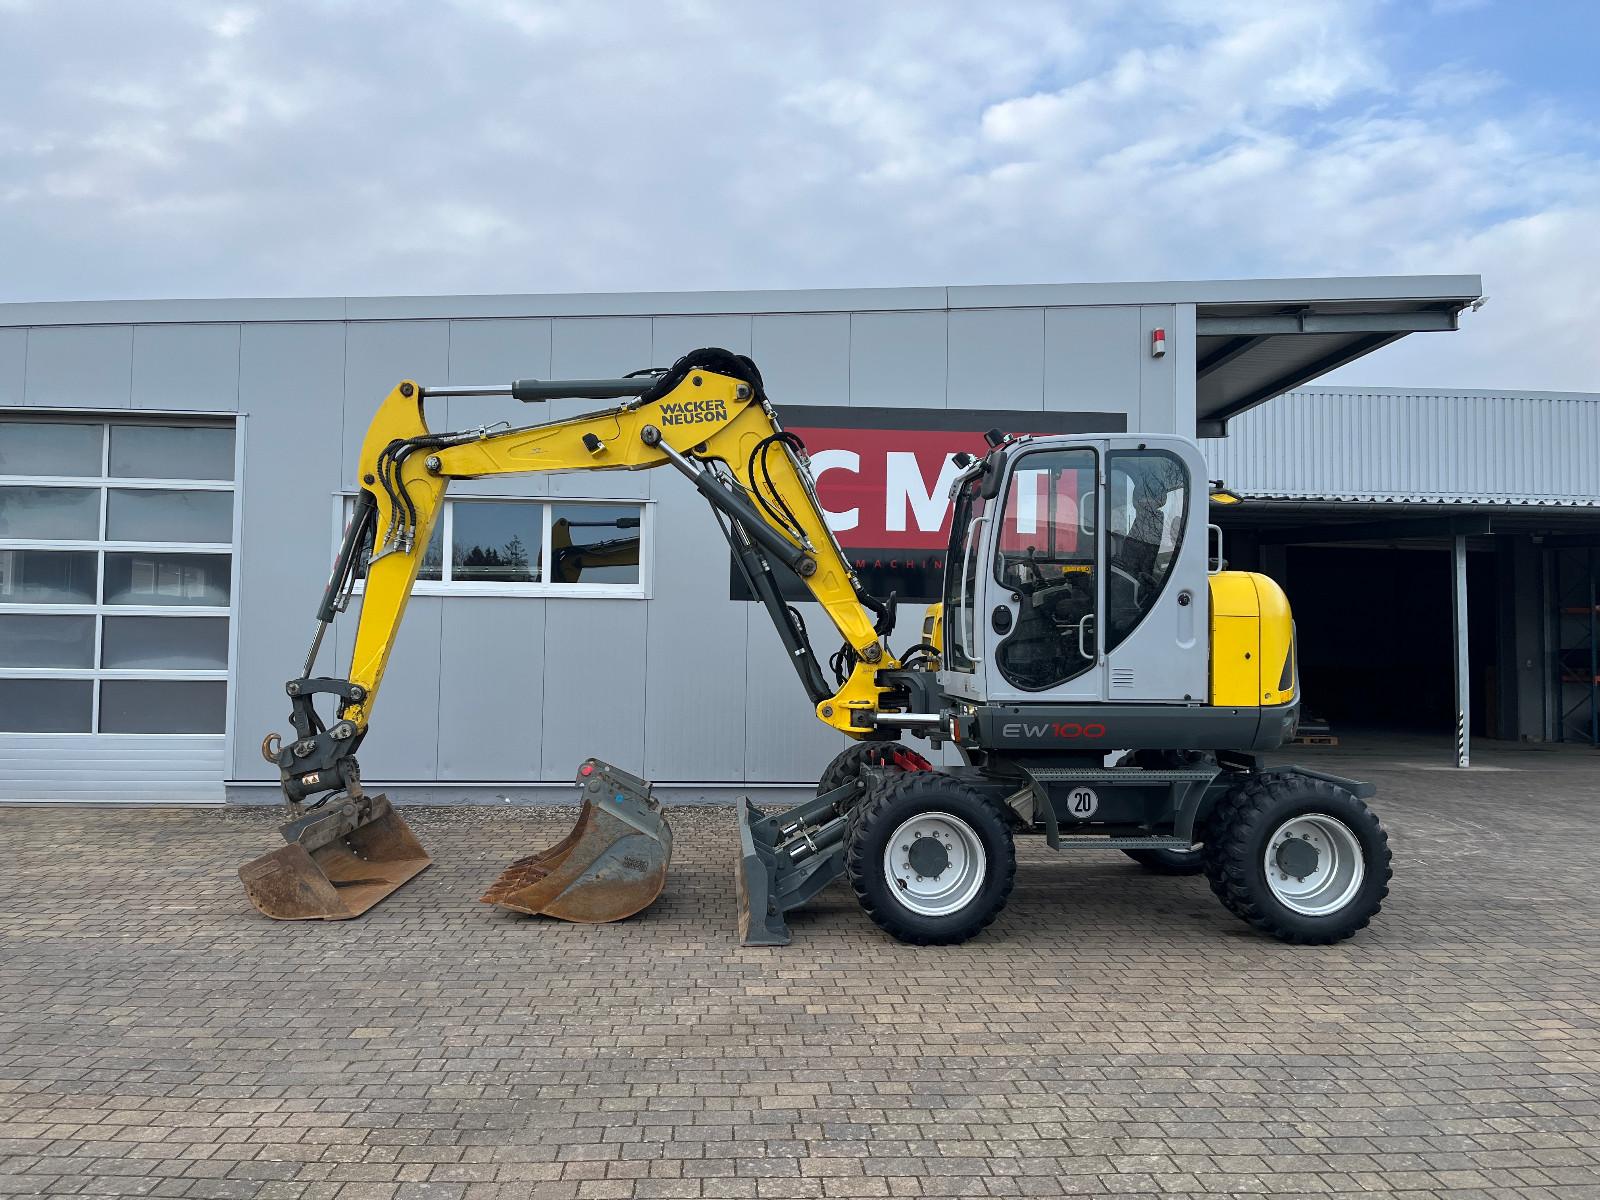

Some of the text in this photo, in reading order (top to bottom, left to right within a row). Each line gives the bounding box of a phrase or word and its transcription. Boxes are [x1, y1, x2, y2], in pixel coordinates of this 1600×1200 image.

[659, 399, 727, 415] WACKER
[661, 410, 728, 426] NEUSON
[855, 559, 943, 569] MACHIN
[1002, 723, 1106, 738] EW100
[1074, 792, 1091, 813] 20
